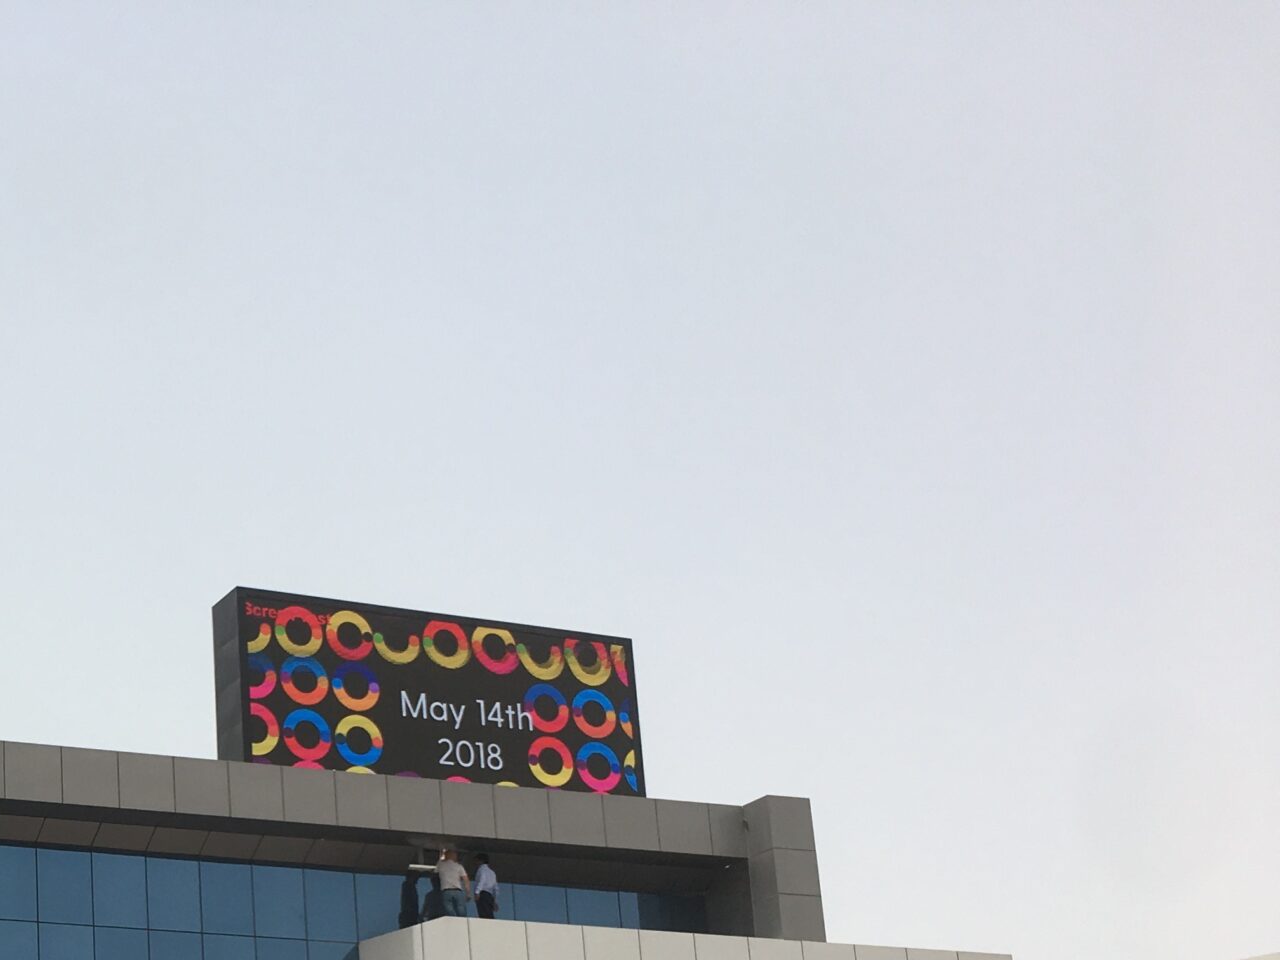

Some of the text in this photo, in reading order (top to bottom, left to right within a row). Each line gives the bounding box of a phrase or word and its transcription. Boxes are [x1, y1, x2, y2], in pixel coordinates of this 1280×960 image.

[400, 689, 534, 732] May 14th
[437, 738, 504, 771] 2018
